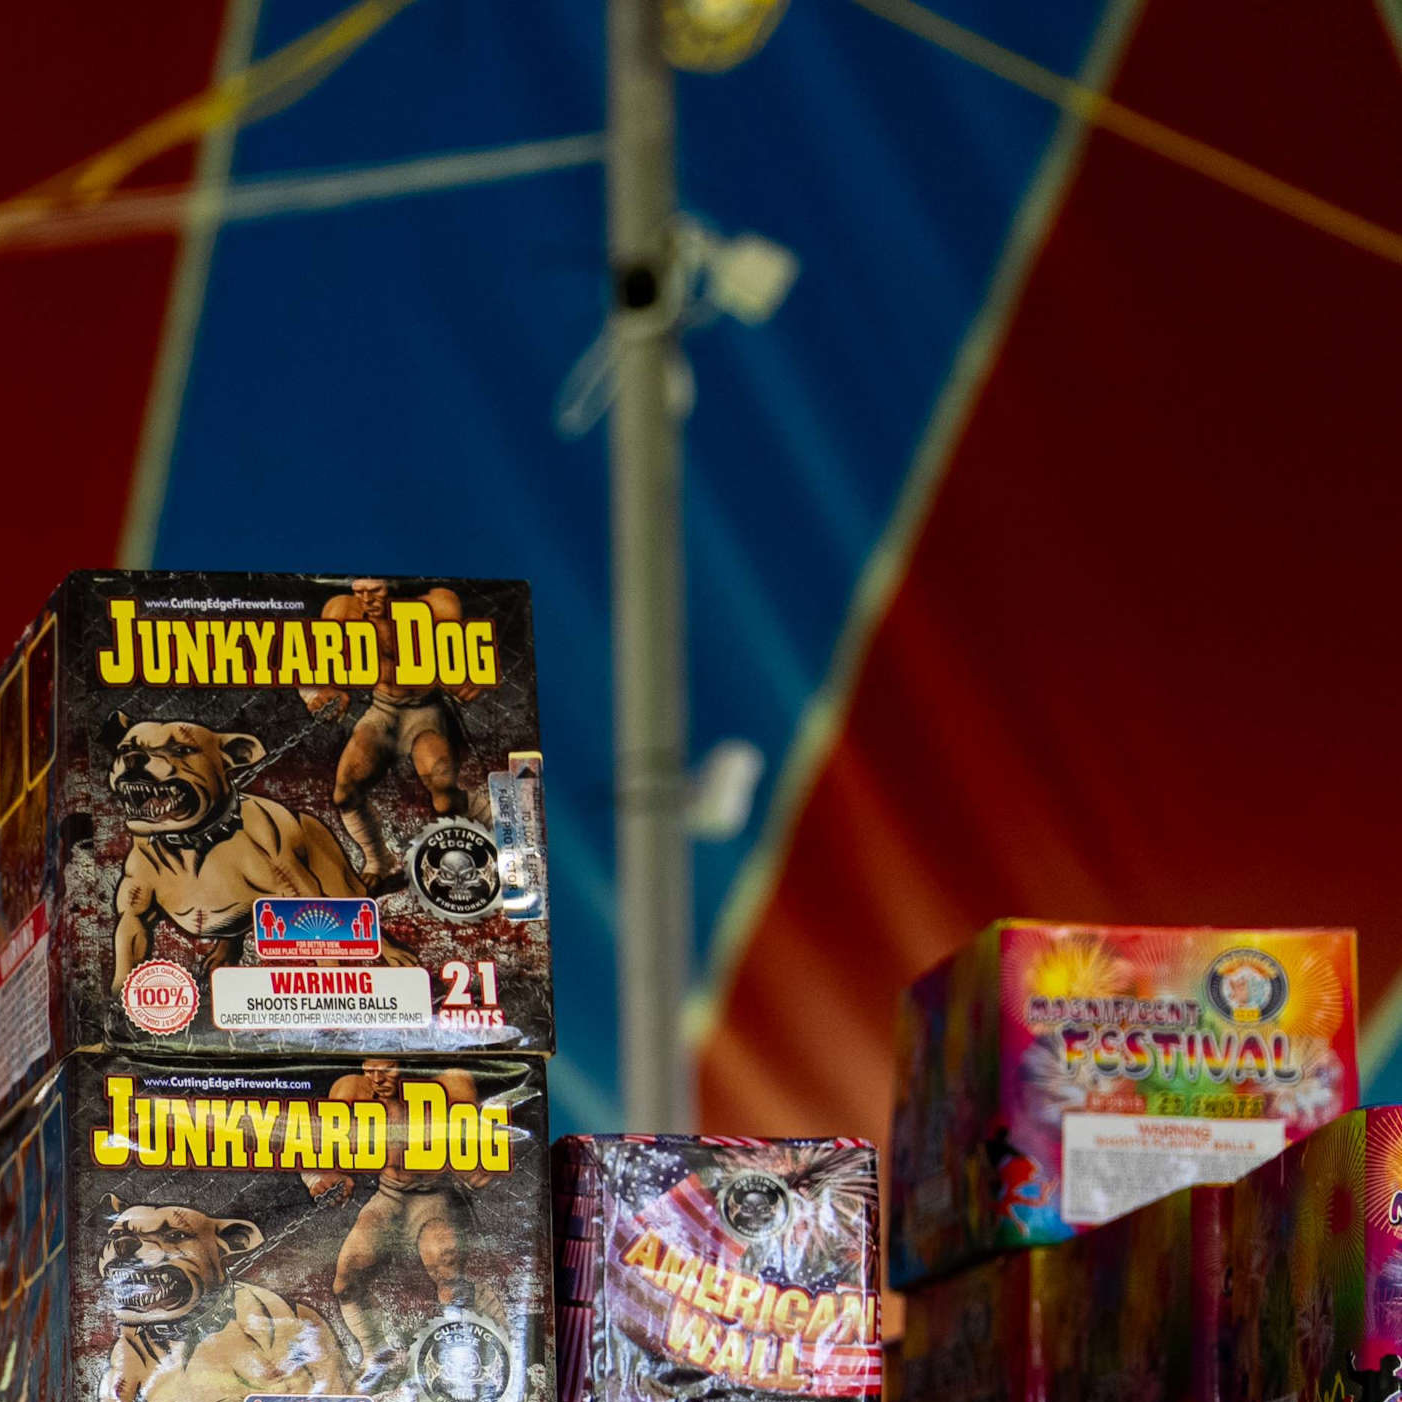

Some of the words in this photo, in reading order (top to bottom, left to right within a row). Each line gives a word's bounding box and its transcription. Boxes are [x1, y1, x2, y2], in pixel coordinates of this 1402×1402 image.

[144, 598, 304, 611] www.CuttingEdgeFireworks.com
[100, 600, 380, 686] JUNKYARD
[392, 601, 496, 686] DOG
[427, 826, 484, 848] CUTTING
[439, 840, 472, 850] EDGE
[436, 897, 488, 914] FIREWORKS
[270, 971, 372, 994] WARNING
[441, 962, 495, 1005] 21
[247, 998, 297, 1010] SHOOTS
[300, 998, 355, 1010] FLAMING
[359, 998, 398, 1010] BALLS
[439, 1009, 504, 1030] SHOTS
[1063, 1028, 1302, 1083] FESTIVAL
[144, 1076, 311, 1091] www.CuttingEdgeFireworks.com
[93, 1076, 388, 1170] JUNKYARD
[402, 1082, 510, 1172] DOG
[624, 1231, 878, 1343] AMERICAN
[666, 1301, 807, 1389] WALL
